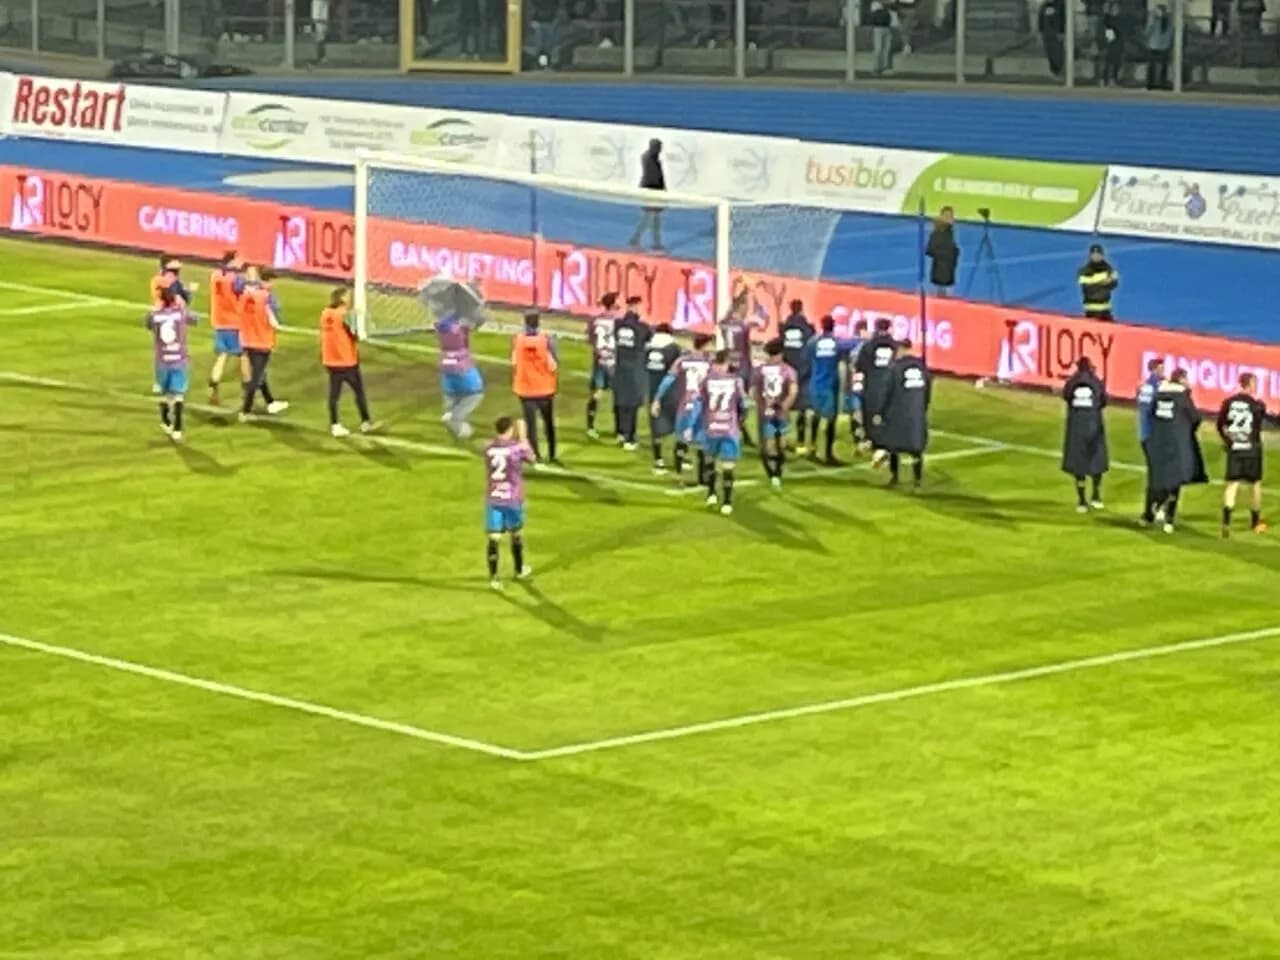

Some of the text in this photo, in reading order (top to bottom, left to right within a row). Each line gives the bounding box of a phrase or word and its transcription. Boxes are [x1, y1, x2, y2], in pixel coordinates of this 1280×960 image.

[13, 76, 125, 132] Restart
[9, 174, 104, 233] TRILOGY
[139, 205, 238, 243] CATERING
[273, 215, 356, 272] TRILOG
[389, 240, 534, 286] BANQUETING
